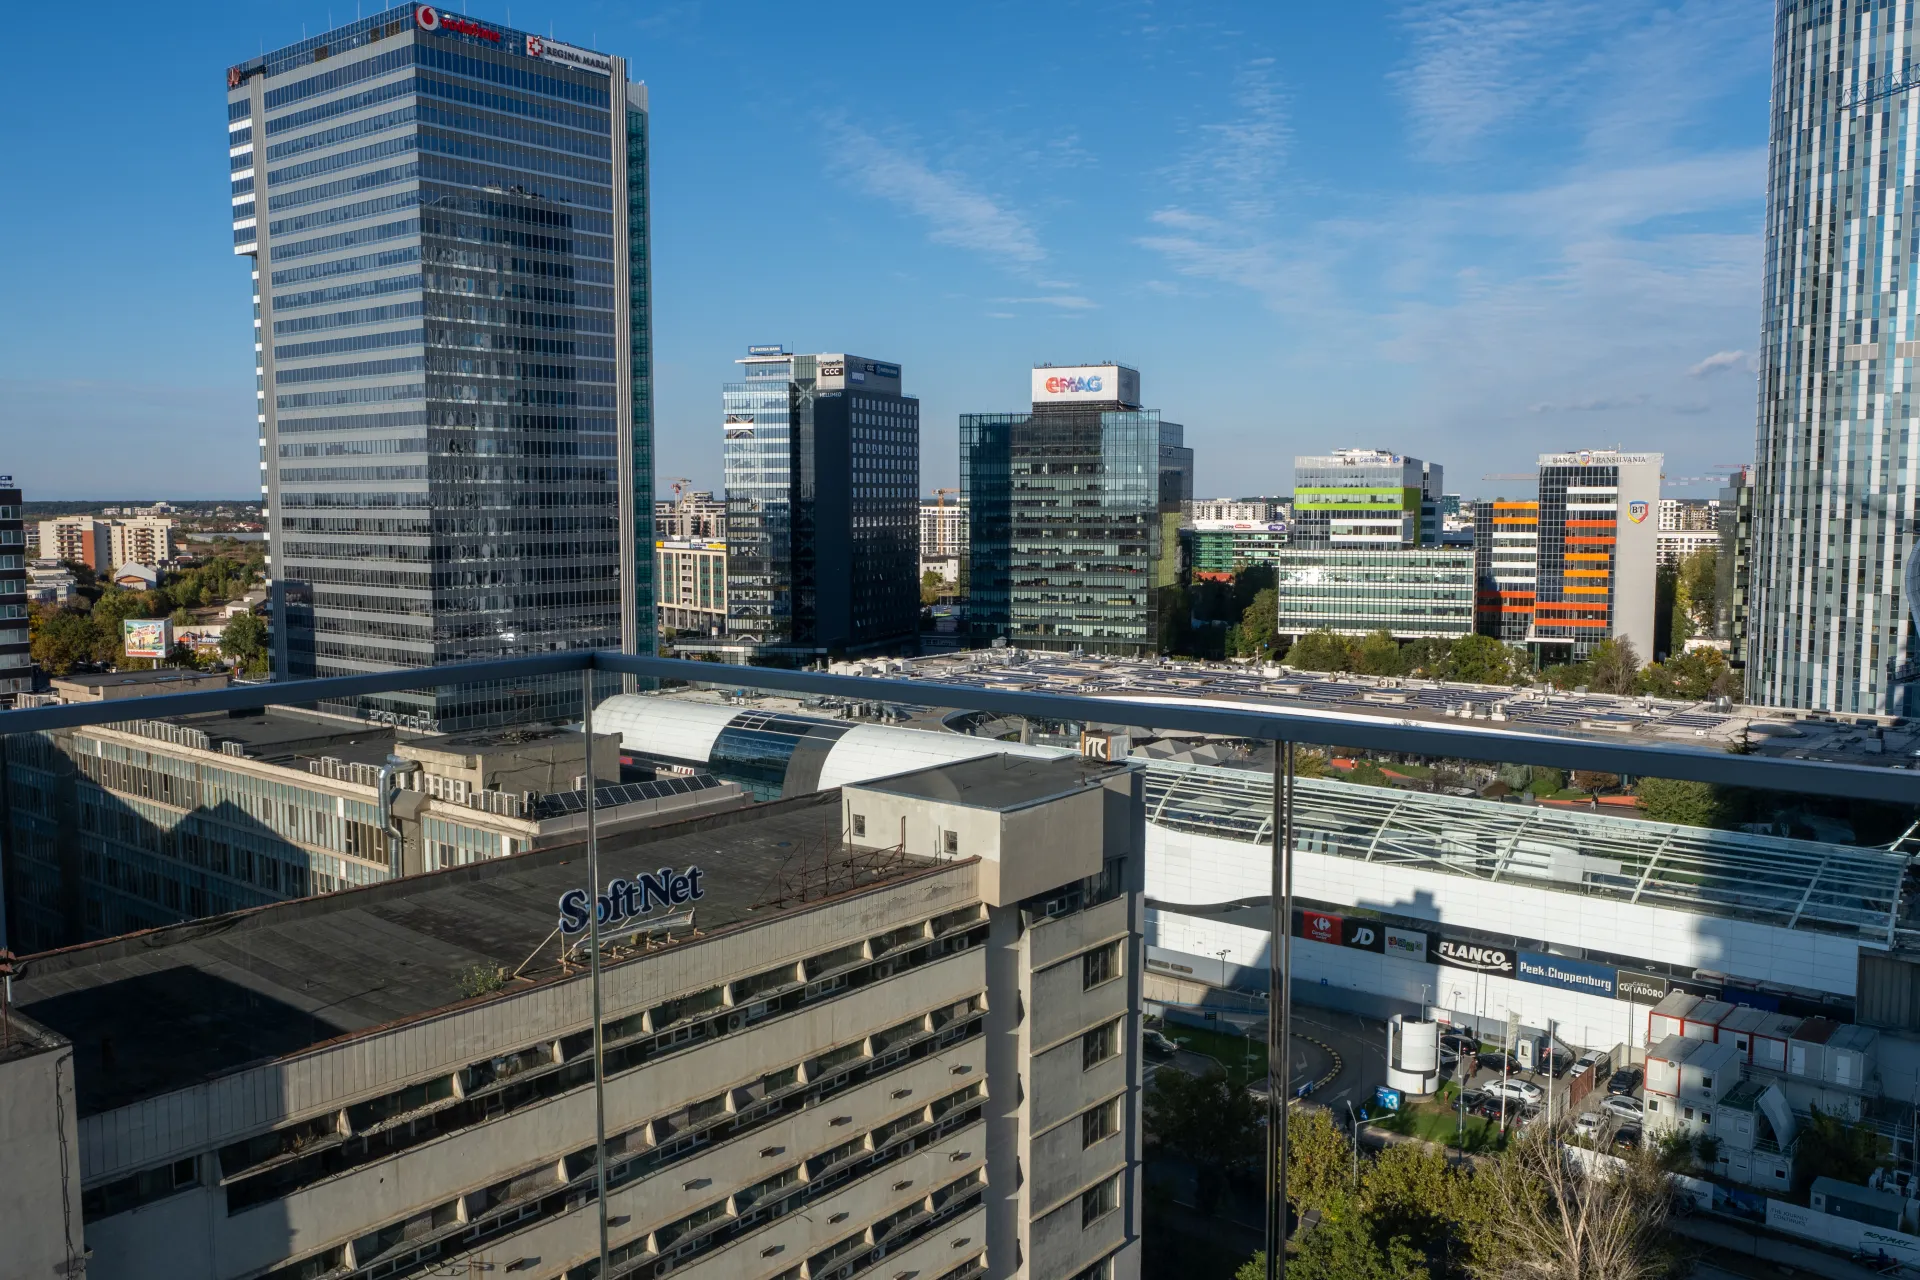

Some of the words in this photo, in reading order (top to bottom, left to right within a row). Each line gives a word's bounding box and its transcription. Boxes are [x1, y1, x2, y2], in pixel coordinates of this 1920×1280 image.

[440, 17, 501, 43] vodafone
[546, 46, 581, 63] REGINA
[582, 55, 611, 71] MARIA
[1592, 456, 1646, 464] TRANSILVANIA
[1631, 505, 1645, 514] BT
[559, 864, 705, 935] SoftNet
[1351, 927, 1375, 946] JD
[1438, 941, 1506, 965] FLANCO
[1520, 961, 1545, 975] Peek
[1548, 966, 1612, 992] Cloppenburg
[1770, 1207, 1783, 1216] THE
[1783, 1211, 1810, 1223] JOURNEY
[1773, 1213, 1807, 1227] CONTINUES
[1863, 1231, 1916, 1247] BOGART
